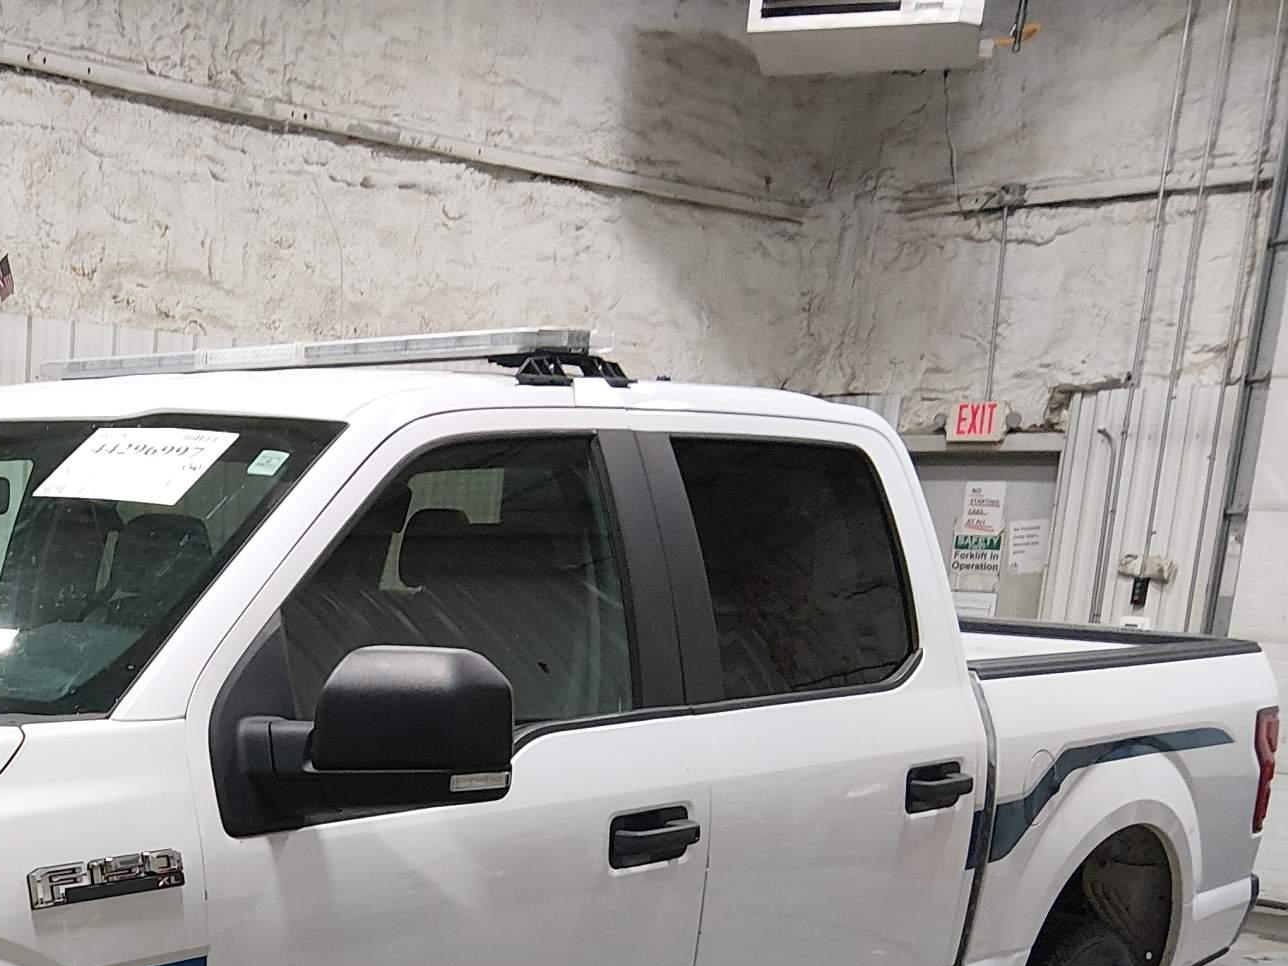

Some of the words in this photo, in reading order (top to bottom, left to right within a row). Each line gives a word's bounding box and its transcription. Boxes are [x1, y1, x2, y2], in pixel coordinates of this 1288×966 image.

[956, 403, 998, 435] EXIT
[956, 535, 1000, 547] SAFETY
[953, 551, 987, 560] Forklift
[952, 561, 999, 571] Operation
